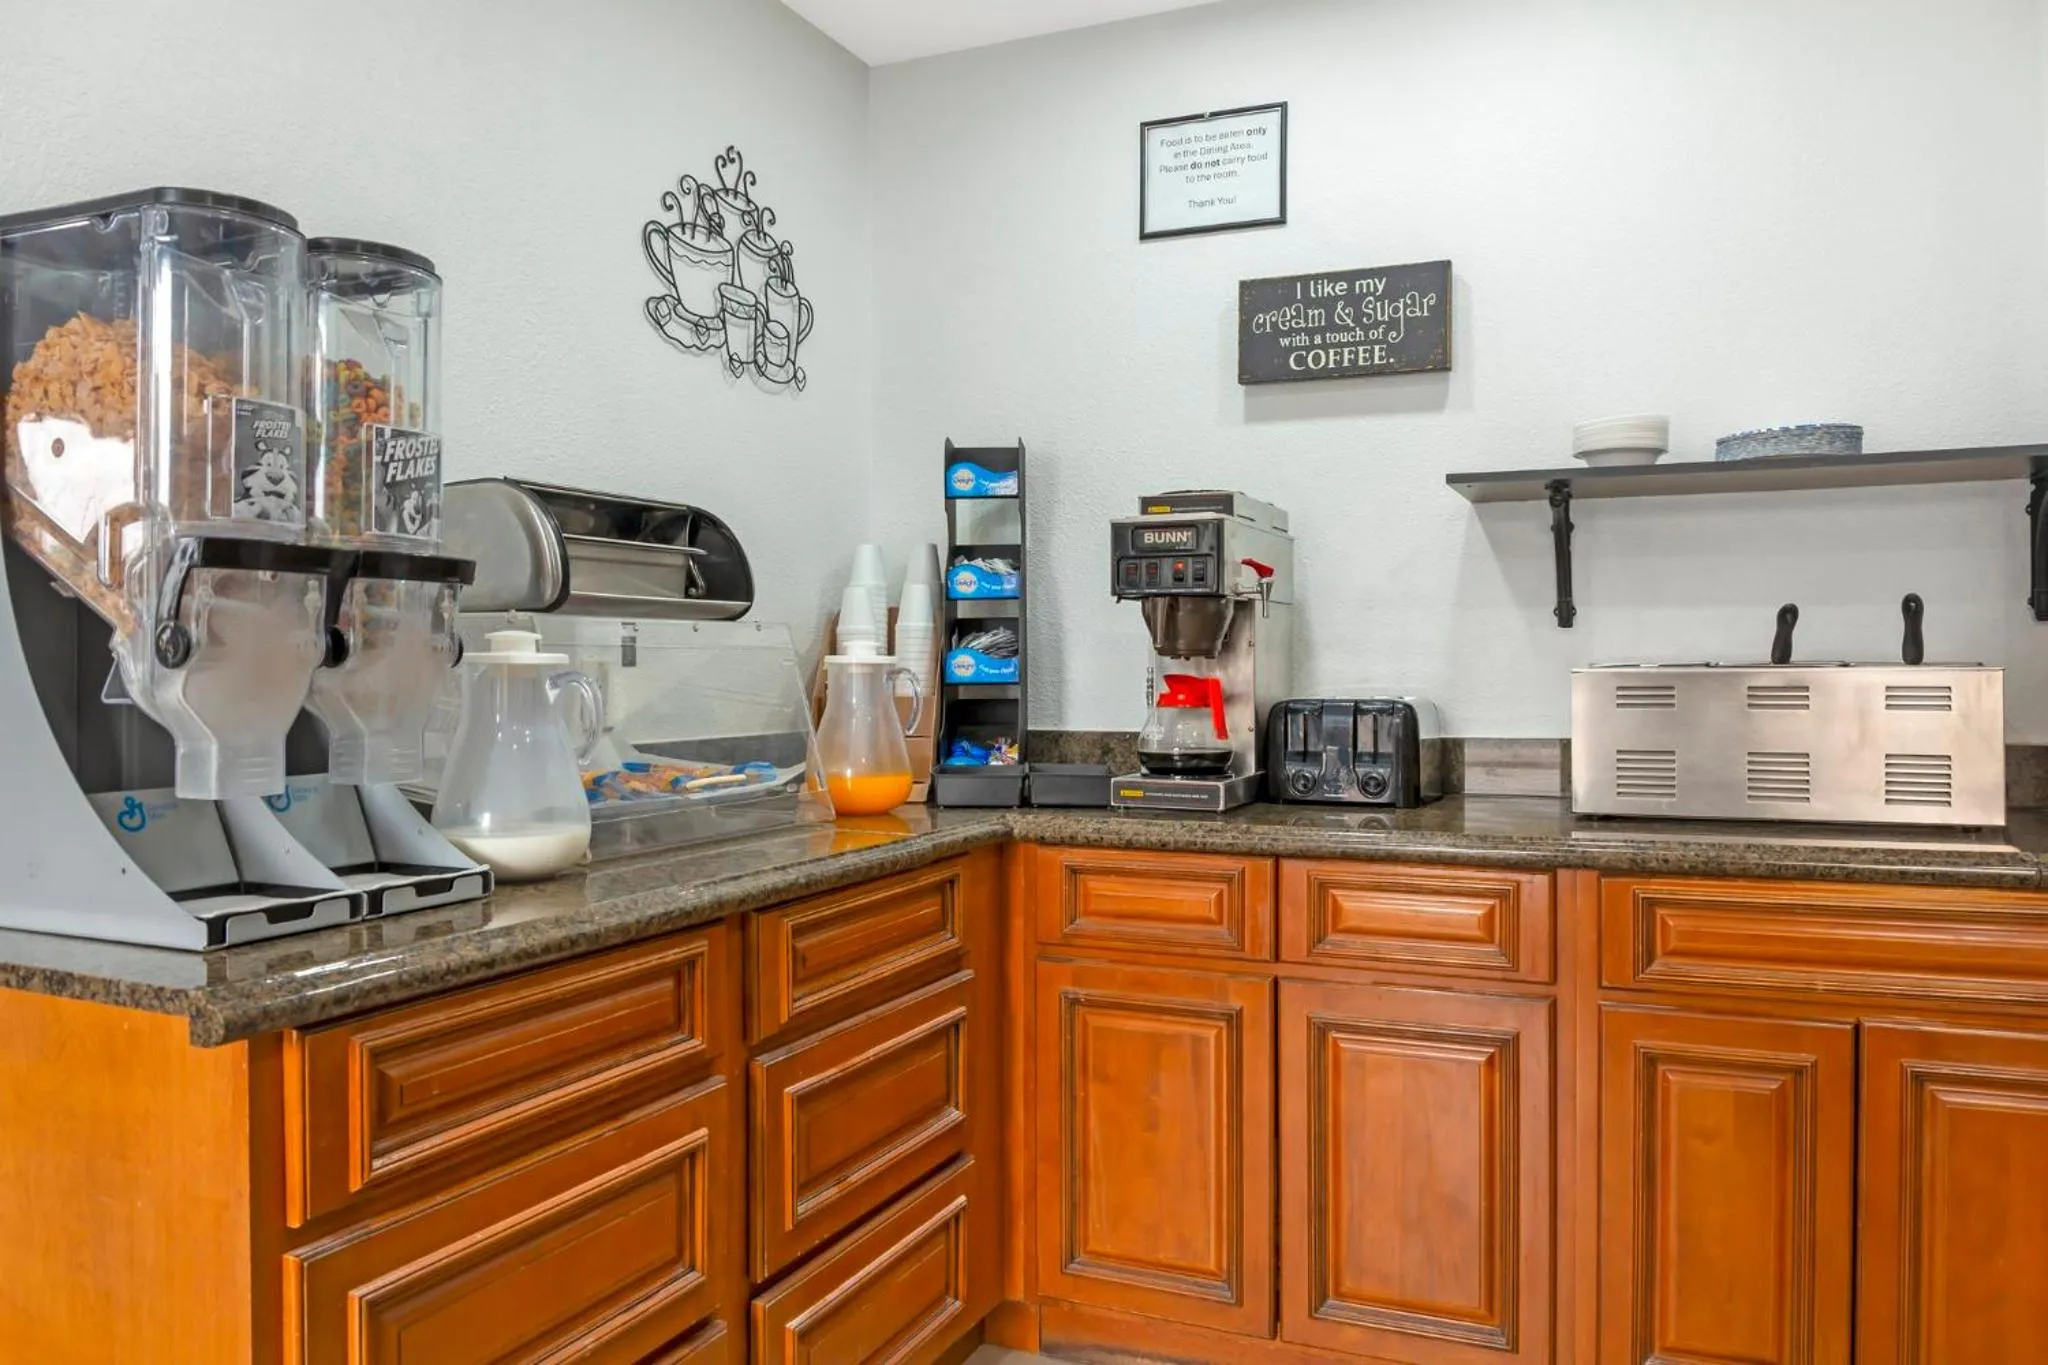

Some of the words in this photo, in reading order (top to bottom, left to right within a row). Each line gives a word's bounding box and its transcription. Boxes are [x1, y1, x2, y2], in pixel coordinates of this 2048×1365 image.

[1160, 136, 1183, 148] Food
[1185, 136, 1192, 145] is
[1194, 134, 1203, 144] to
[1205, 133, 1217, 142] be
[1219, 129, 1244, 140] eaten
[1246, 126, 1267, 137] only
[1174, 151, 1181, 159] in
[1183, 149, 1198, 158] the
[1200, 144, 1229, 156] Dining
[1159, 163, 1188, 174] Please
[1190, 161, 1202, 170] do
[1205, 159, 1220, 168] not
[1222, 156, 1246, 166] carry
[1247, 152, 1268, 162] food
[1185, 175, 1195, 184] to
[1197, 173, 1212, 182] the
[1188, 197, 1215, 208] Thank
[1217, 196, 1237, 206] You!
[1295, 281, 1301, 300] I
[1309, 279, 1348, 299] like
[1355, 276, 1387, 296] my
[1252, 303, 1326, 334] cream
[1334, 300, 1356, 327] &
[1279, 332, 1310, 348] with
[1314, 334, 1322, 345] a
[1325, 327, 1365, 344] touch
[1368, 324, 1387, 340] of
[1288, 344, 1395, 371] COFFEE.
[255, 429, 289, 439] FLAKES
[385, 456, 437, 483] FLAKES
[1144, 530, 1187, 544] BUNN
